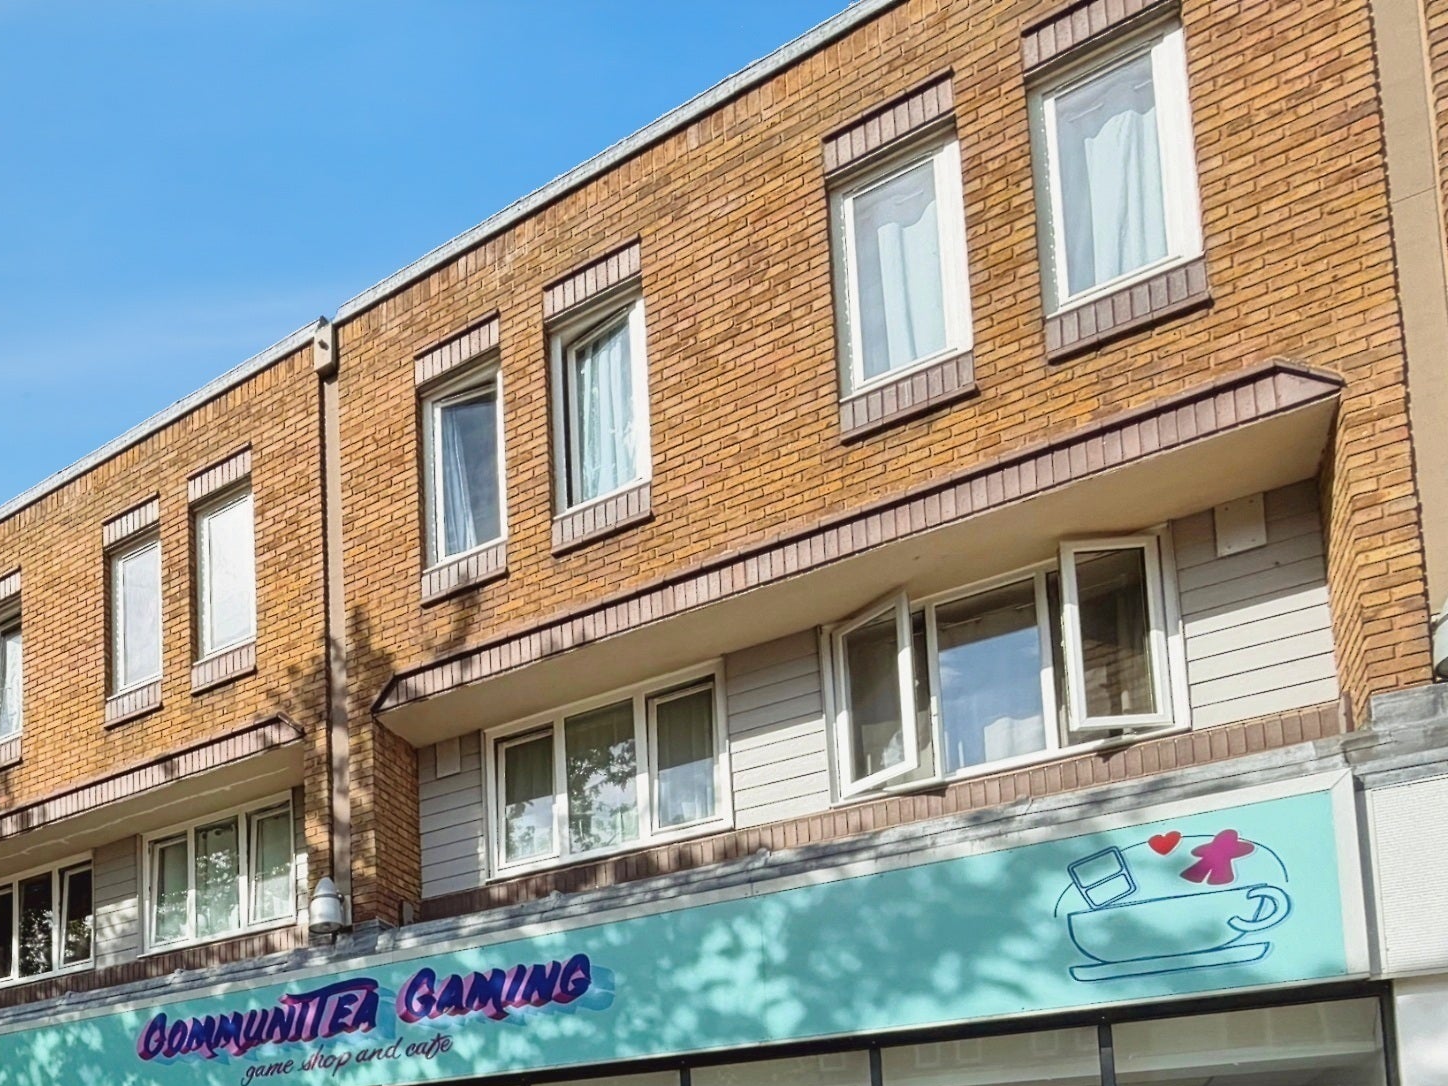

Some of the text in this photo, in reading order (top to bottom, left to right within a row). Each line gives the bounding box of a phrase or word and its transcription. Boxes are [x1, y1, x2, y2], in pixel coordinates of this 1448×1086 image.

[136, 953, 592, 1061] COMMUNITEA GAMING
[298, 1044, 352, 1077] shop
[356, 1037, 402, 1063] and
[405, 1032, 453, 1059] cafe
